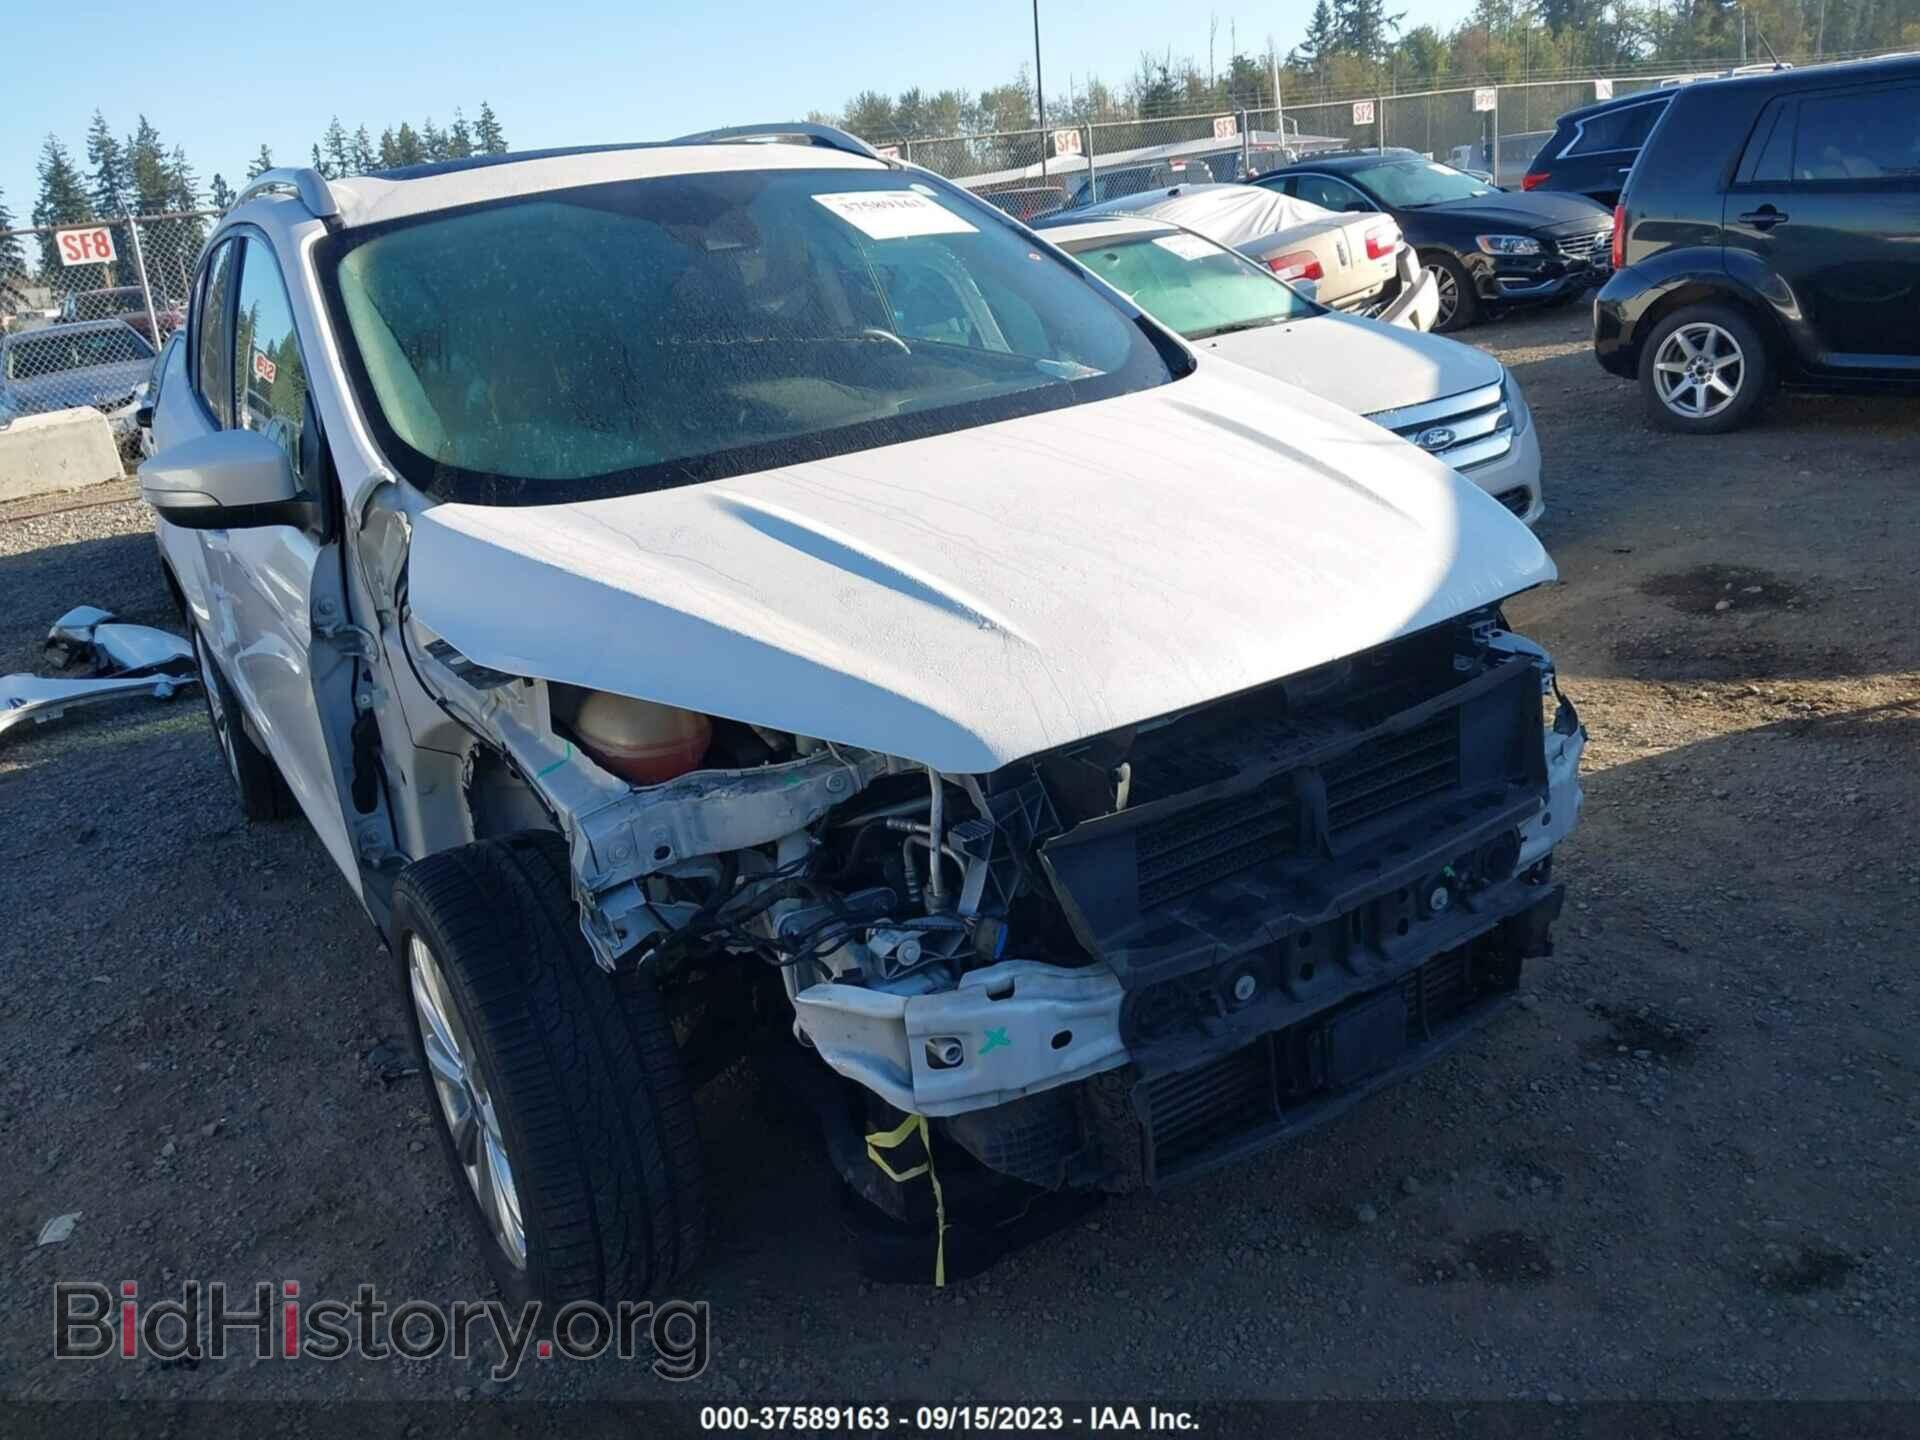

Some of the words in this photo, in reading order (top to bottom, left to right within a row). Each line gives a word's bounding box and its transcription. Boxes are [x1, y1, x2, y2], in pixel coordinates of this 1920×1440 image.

[1355, 103, 1373, 122] SF2
[1216, 119, 1236, 138] SF3
[1056, 131, 1079, 152] SF4
[63, 231, 110, 261] SF8
